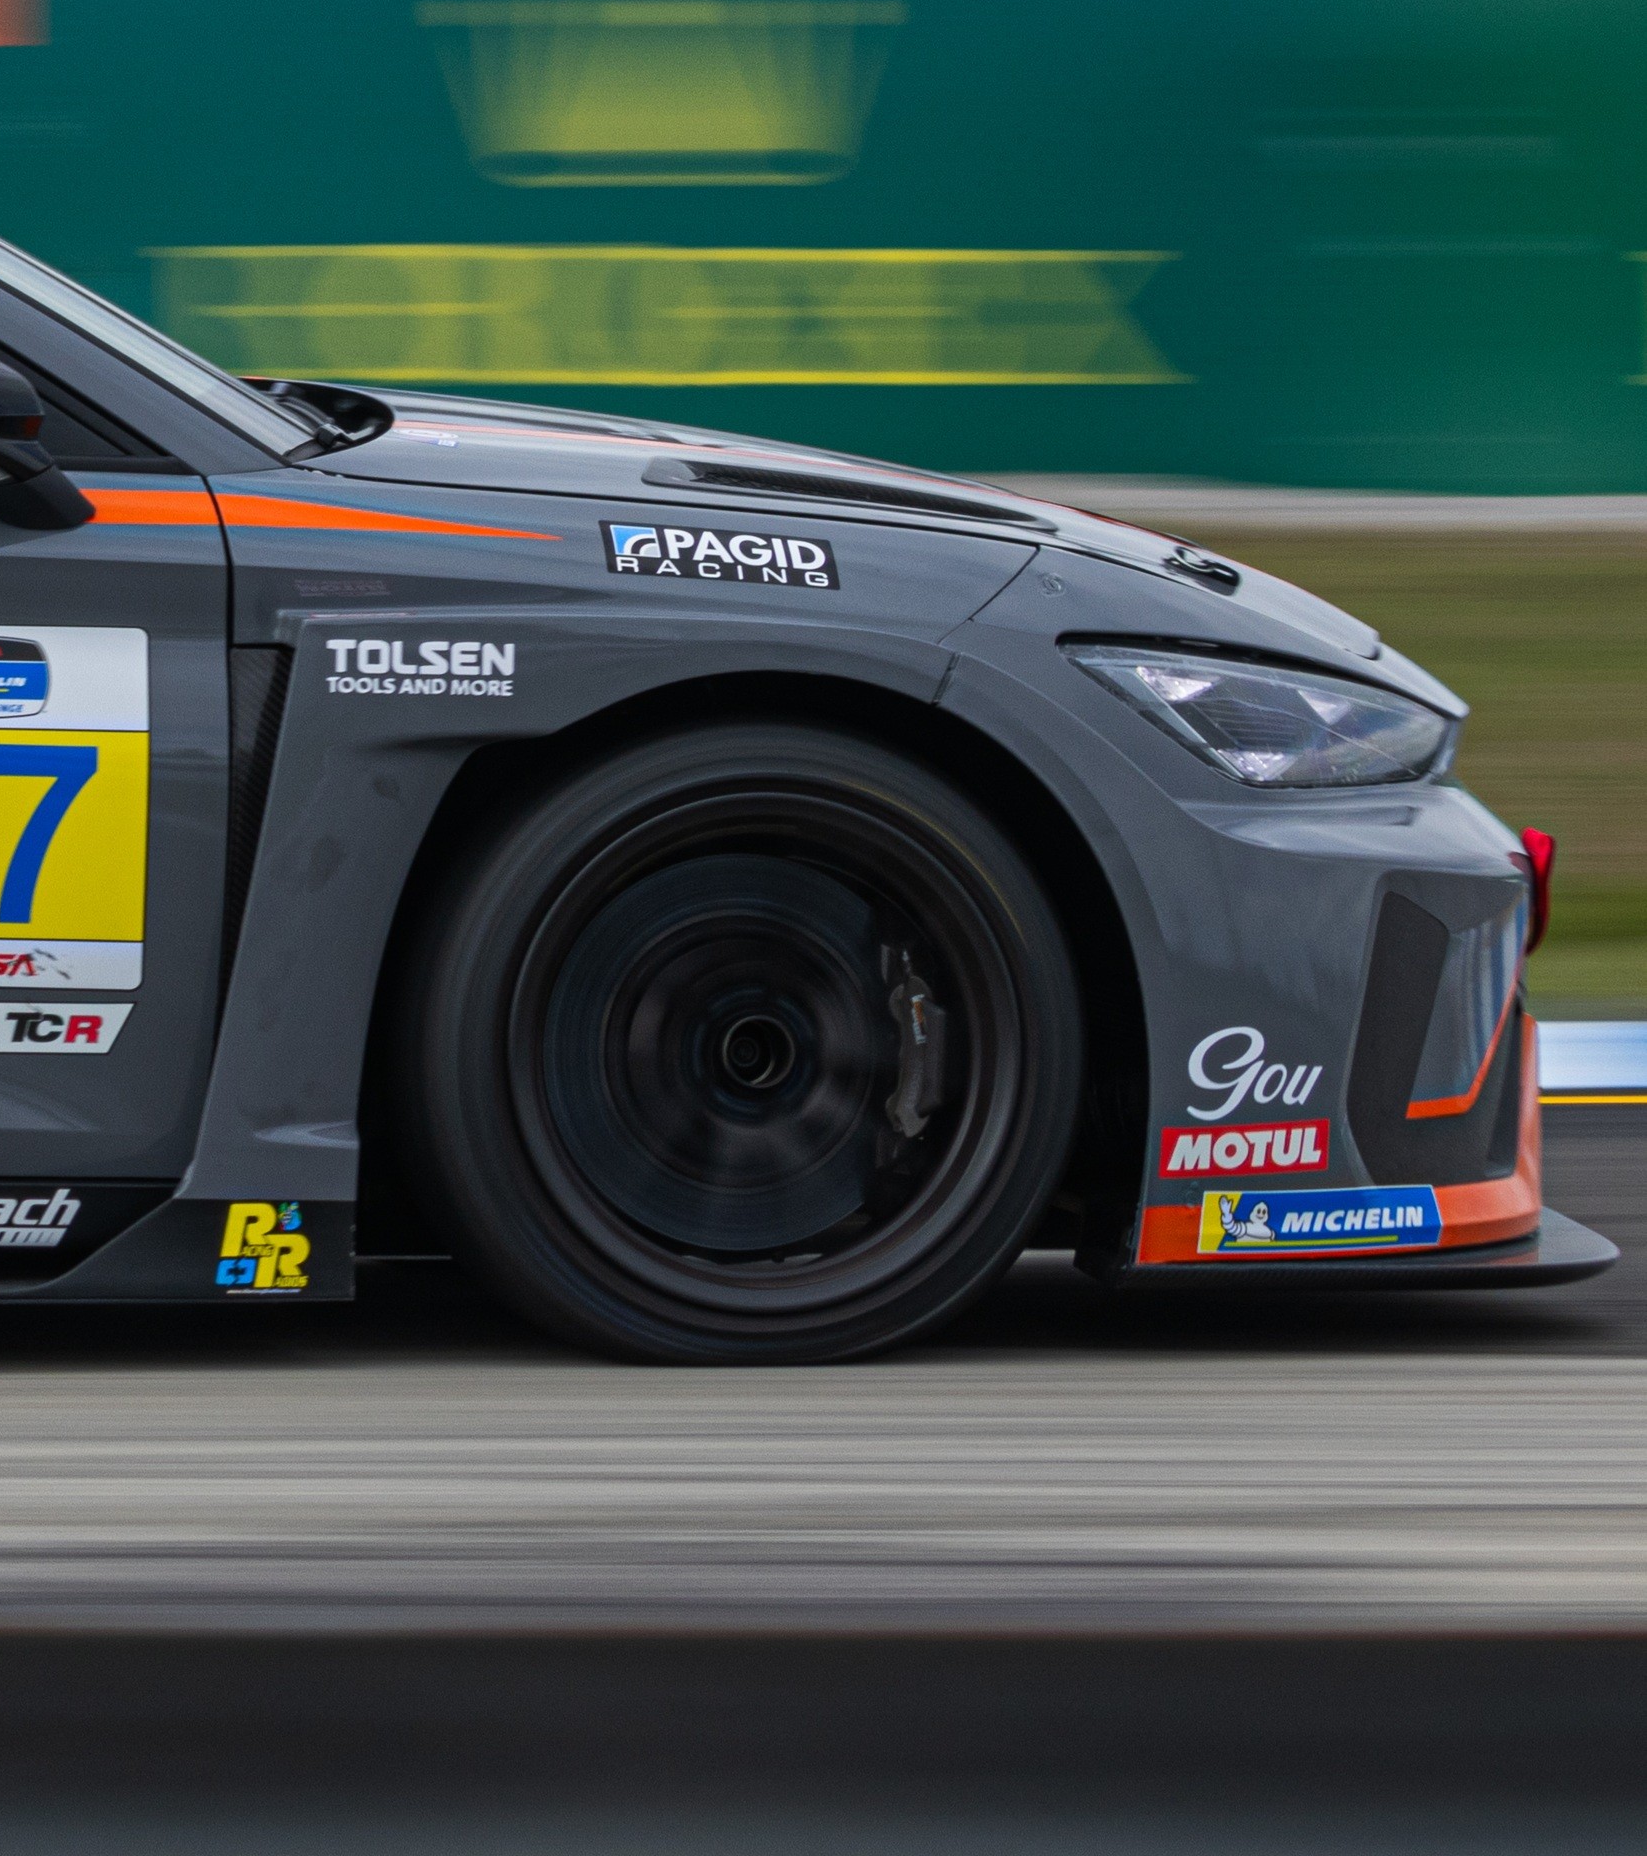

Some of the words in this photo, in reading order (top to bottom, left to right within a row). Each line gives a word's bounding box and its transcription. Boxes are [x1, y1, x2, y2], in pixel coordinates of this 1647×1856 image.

[663, 528, 827, 570] PAGID
[615, 555, 830, 588] RACING
[325, 638, 516, 676] TOLSEN
[325, 676, 397, 694] TOOLS
[398, 678, 448, 695] AND
[450, 679, 514, 697] MORE
[5, 1012, 104, 1044] TCR
[1166, 1127, 1322, 1172] MOTUL
[1280, 1205, 1424, 1235] MICHELIN
